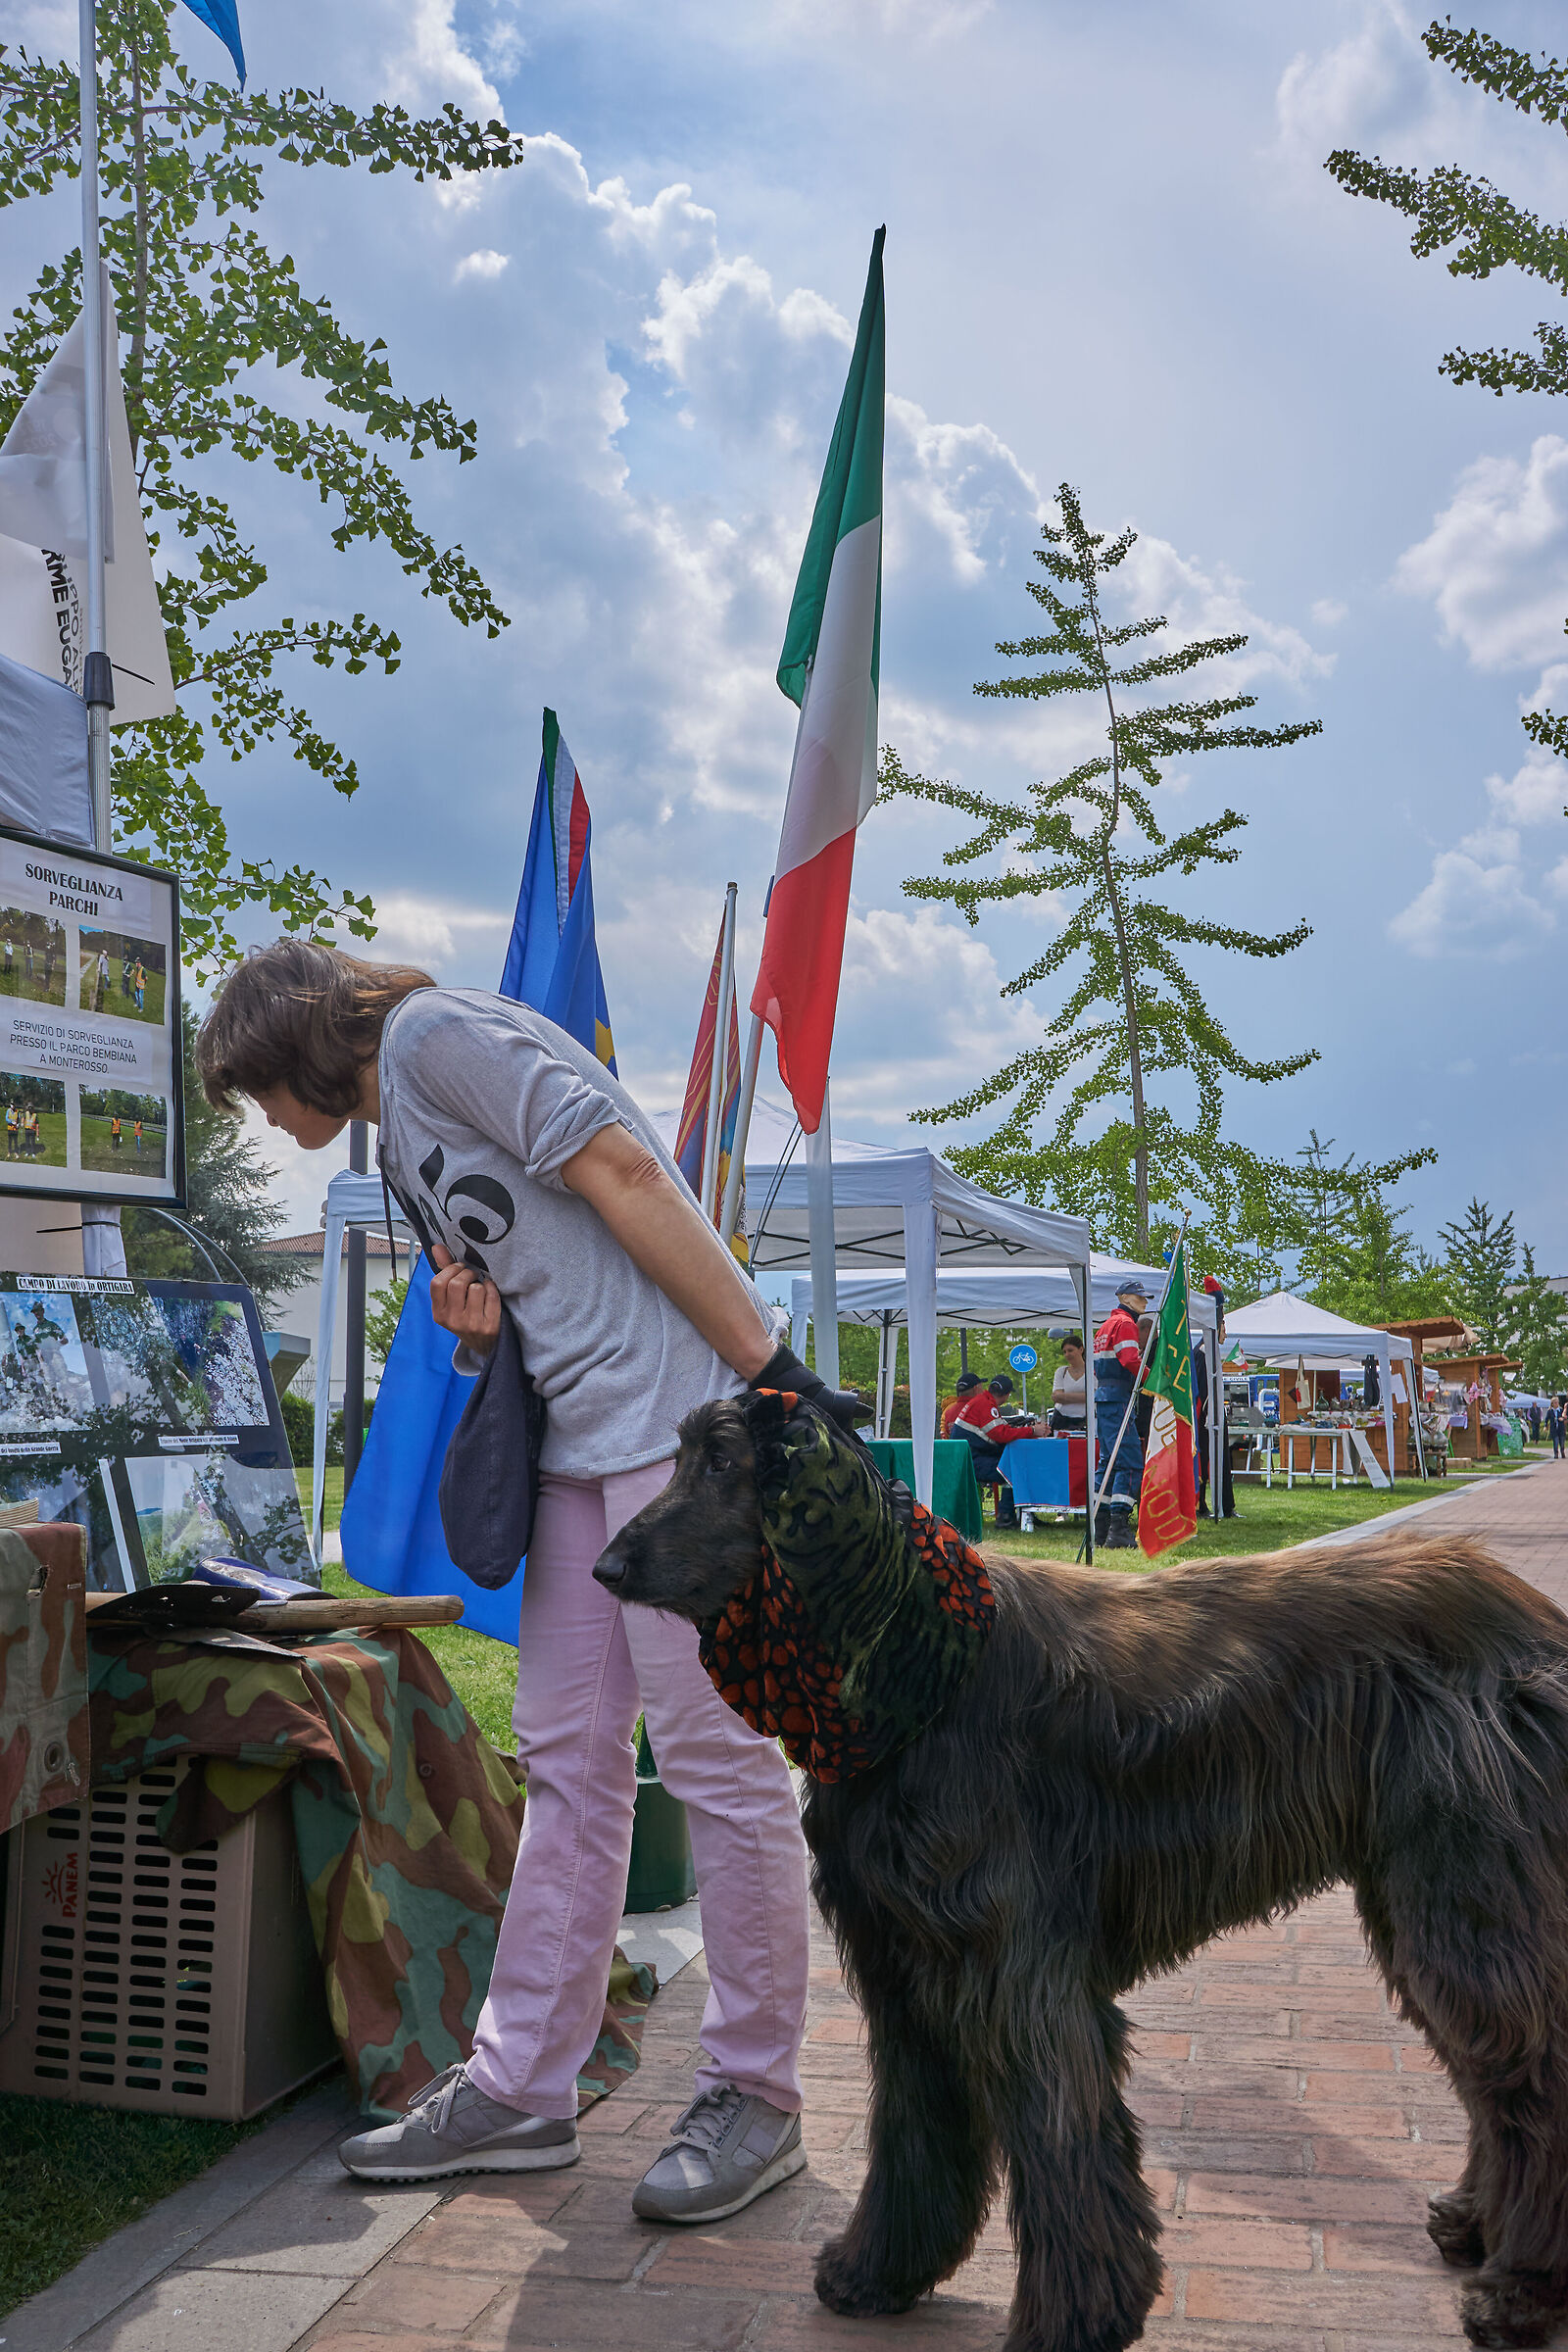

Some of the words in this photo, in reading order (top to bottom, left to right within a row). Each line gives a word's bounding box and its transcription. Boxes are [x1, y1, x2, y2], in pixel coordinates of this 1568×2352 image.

[56, 608, 74, 689] EUGA
[25, 863, 123, 902] SORVEGLIANZA
[49, 891, 99, 916] PARCHI
[10, 1034, 47, 1050] PRESSO
[49, 1041, 58, 1052] IL
[60, 1042, 91, 1056] PARCO
[92, 1047, 137, 1064] BEMBIANA
[13, 1019, 54, 1037] SERVIZIO
[56, 1028, 66, 1039] DI
[68, 1029, 134, 1050] SORVEGLIANZA
[39, 1054, 47, 1064] A
[49, 1054, 110, 1074] MONTEROSSO.
[19, 1278, 45, 1290] CAMPO
[46, 1279, 56, 1290] DI
[57, 1279, 86, 1291] LAVORO
[97, 1281, 133, 1293] ORTIGARA
[62, 1852, 78, 1918] PANEM
